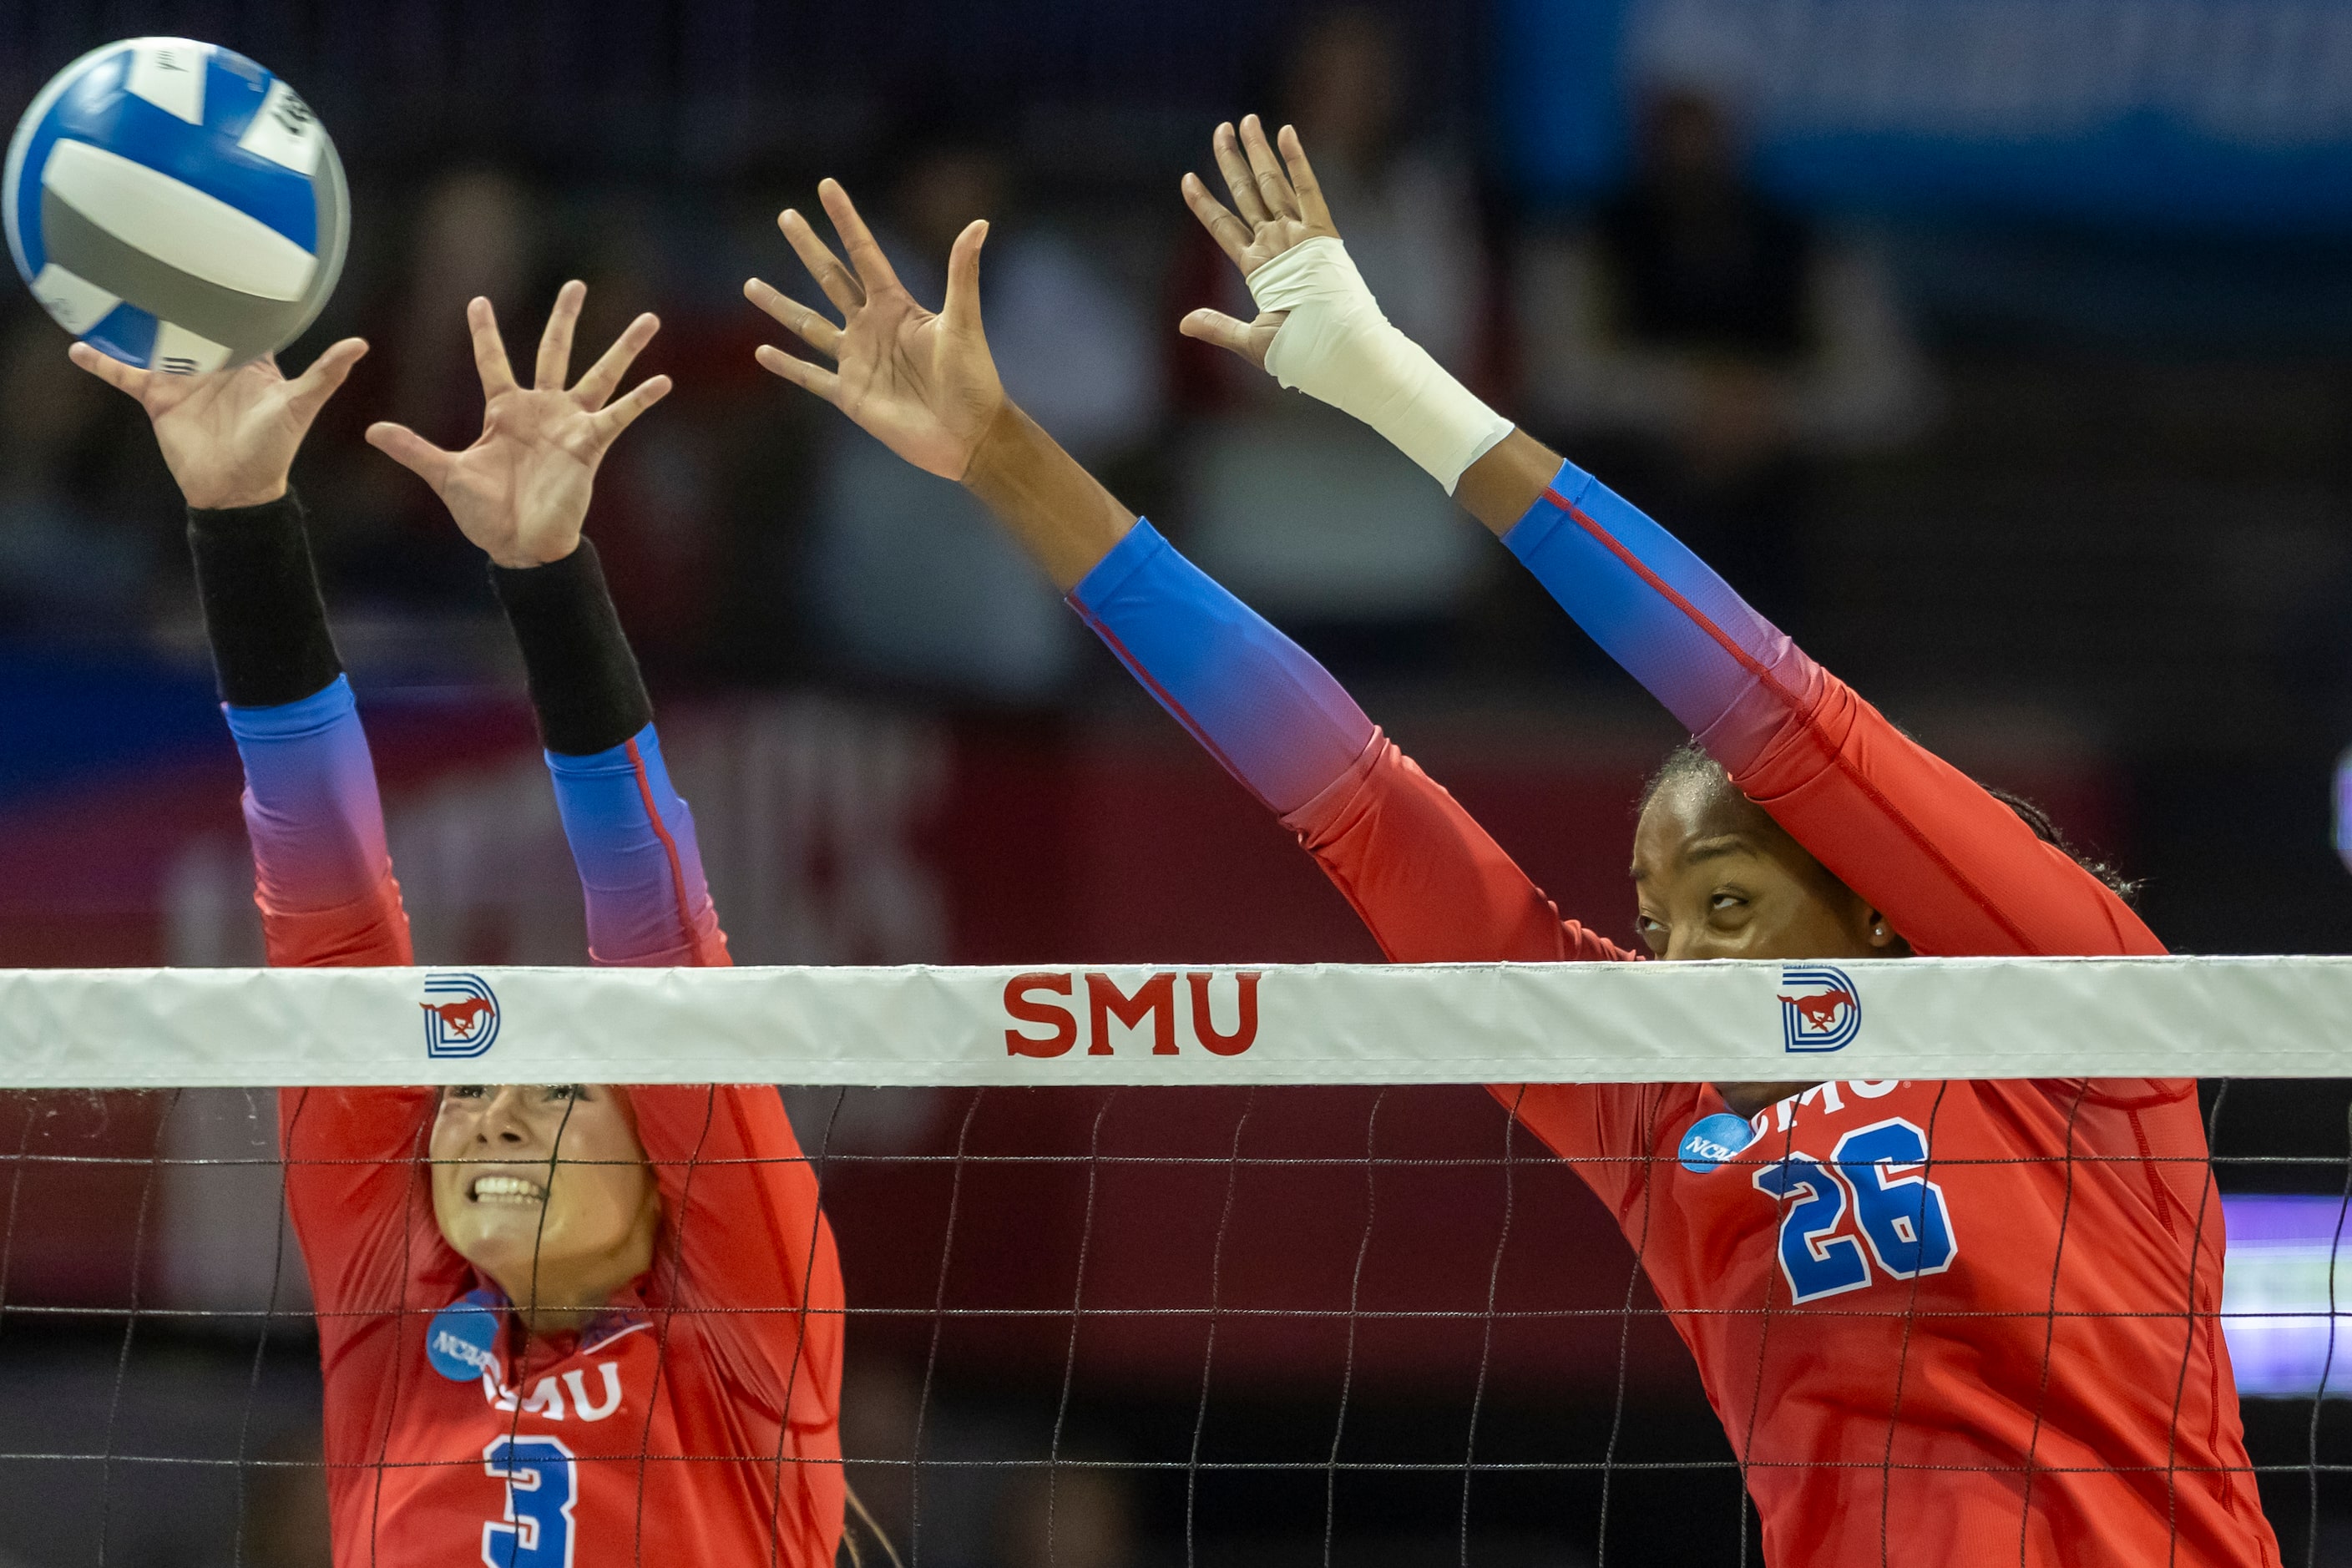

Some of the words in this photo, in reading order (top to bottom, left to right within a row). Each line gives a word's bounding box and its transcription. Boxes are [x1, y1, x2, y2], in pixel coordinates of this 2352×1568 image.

[1003, 972, 1262, 1059] SMU
[1752, 1115, 1959, 1306] 26
[481, 1434, 578, 1568] 3
